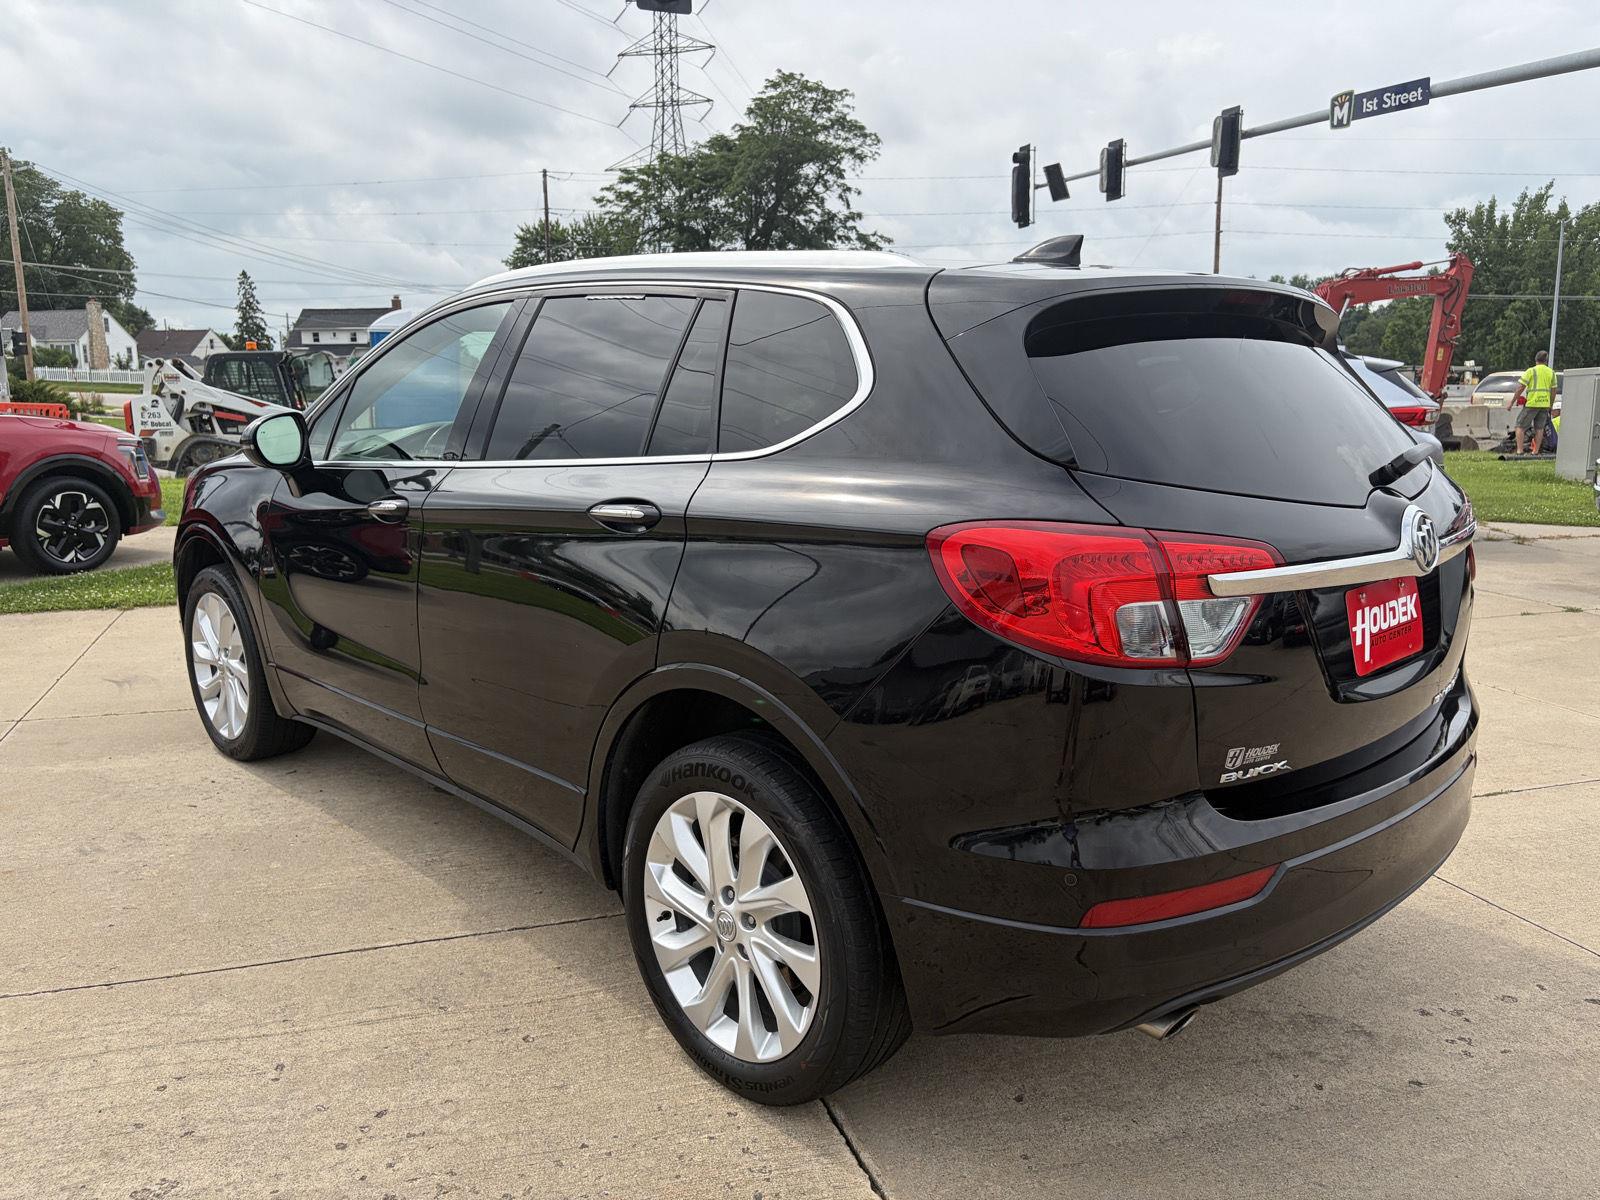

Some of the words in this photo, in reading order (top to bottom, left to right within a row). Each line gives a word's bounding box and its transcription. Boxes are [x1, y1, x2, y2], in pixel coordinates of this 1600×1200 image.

[1362, 98, 1379, 113] 1st
[1382, 87, 1423, 108] Street
[147, 411, 162, 419] 263
[1352, 592, 1418, 663] HOUDEK
[1370, 636, 1387, 648] AUTO
[1389, 625, 1412, 640] CENTER
[1244, 742, 1281, 759] HOUDEK
[1220, 760, 1293, 783] BUICK
